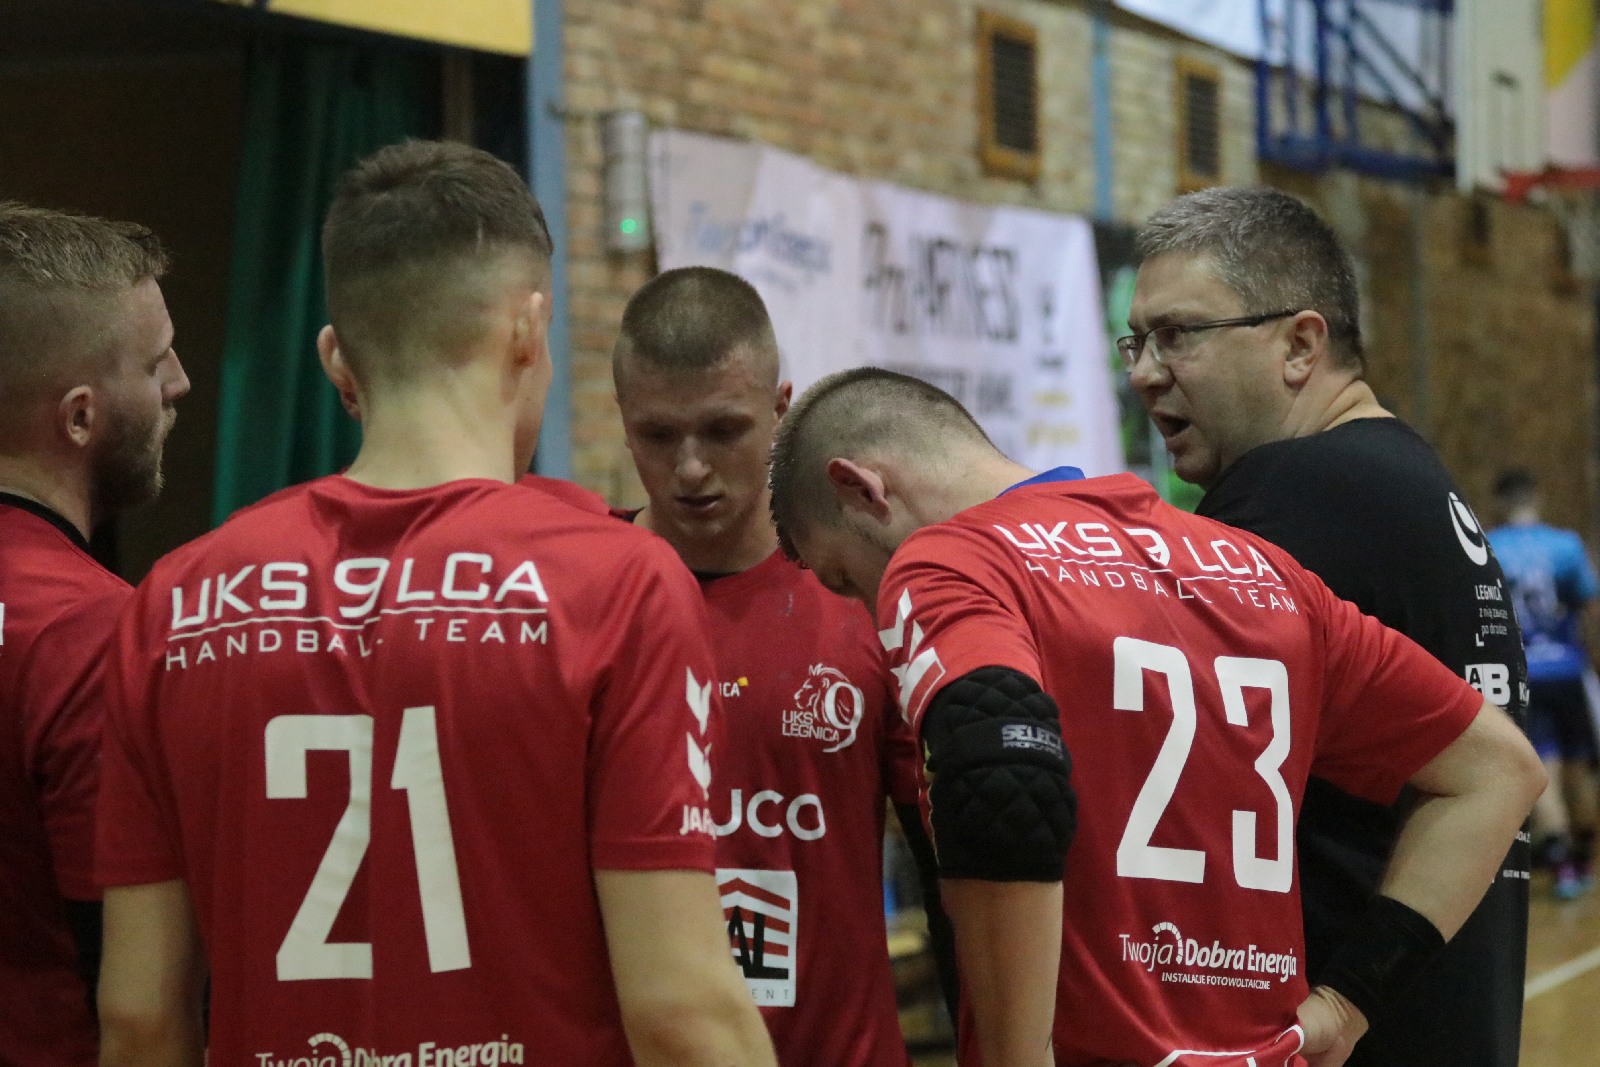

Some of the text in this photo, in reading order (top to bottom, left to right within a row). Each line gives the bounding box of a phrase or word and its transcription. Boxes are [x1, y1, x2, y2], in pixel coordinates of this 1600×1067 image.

[993, 521, 1123, 557] UKS
[1182, 536, 1283, 581] LCA
[171, 562, 308, 630] UKS
[1228, 586, 1299, 615] TEAM
[165, 618, 548, 671] HANDBAL TEAM
[782, 710, 814, 726] UKS
[782, 722, 840, 743] LEGNICA
[1002, 724, 1062, 752] SELEC
[1112, 636, 1294, 894] 23
[264, 705, 472, 981] 21
[1119, 934, 1297, 983] Twoja Dobra Energia
[751, 988, 790, 1000] ENT
[418, 1034, 525, 1067] Energia
